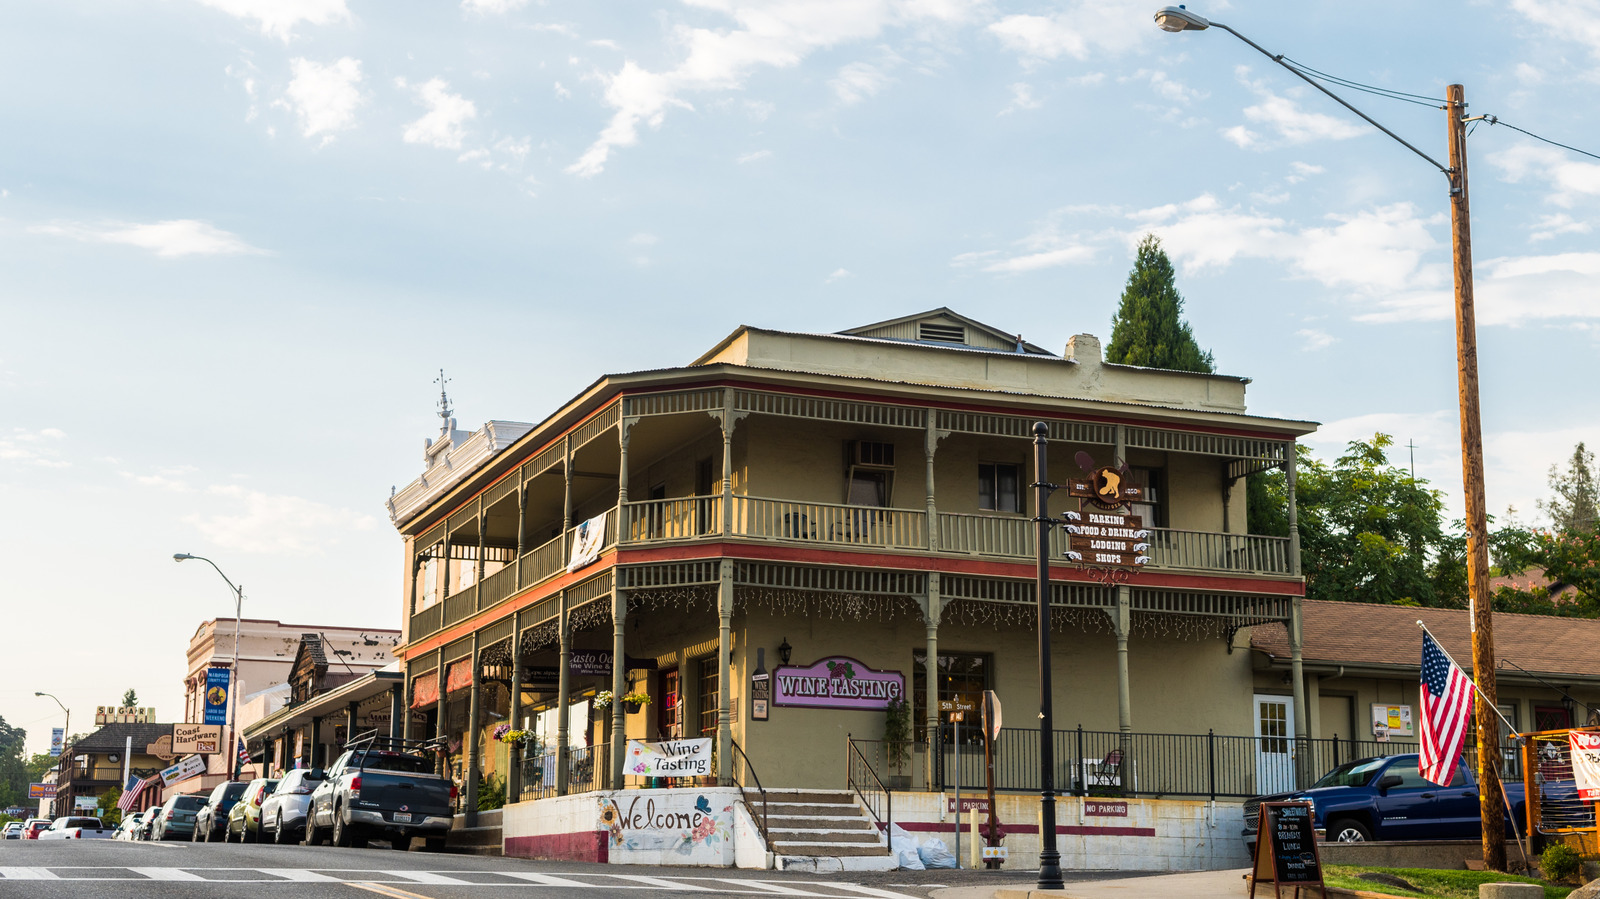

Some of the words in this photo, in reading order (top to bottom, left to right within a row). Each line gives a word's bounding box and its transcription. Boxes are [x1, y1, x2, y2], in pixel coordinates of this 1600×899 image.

[1089, 514, 1124, 525] PARKING
[1080, 526, 1099, 536] FOOD
[1100, 528, 1107, 536] &
[1108, 528, 1134, 538] DRINK
[1090, 540, 1126, 550] LODGING
[1096, 554, 1121, 563] SHOPS
[779, 676, 829, 697] WINE
[831, 679, 900, 700] TASTING
[176, 726, 200, 736] Coast
[176, 732, 217, 744] Hardware
[660, 742, 700, 756] Wine
[654, 757, 706, 774] Tasting
[610, 796, 702, 830] Welcome
[1098, 806, 1126, 814] PARKING
